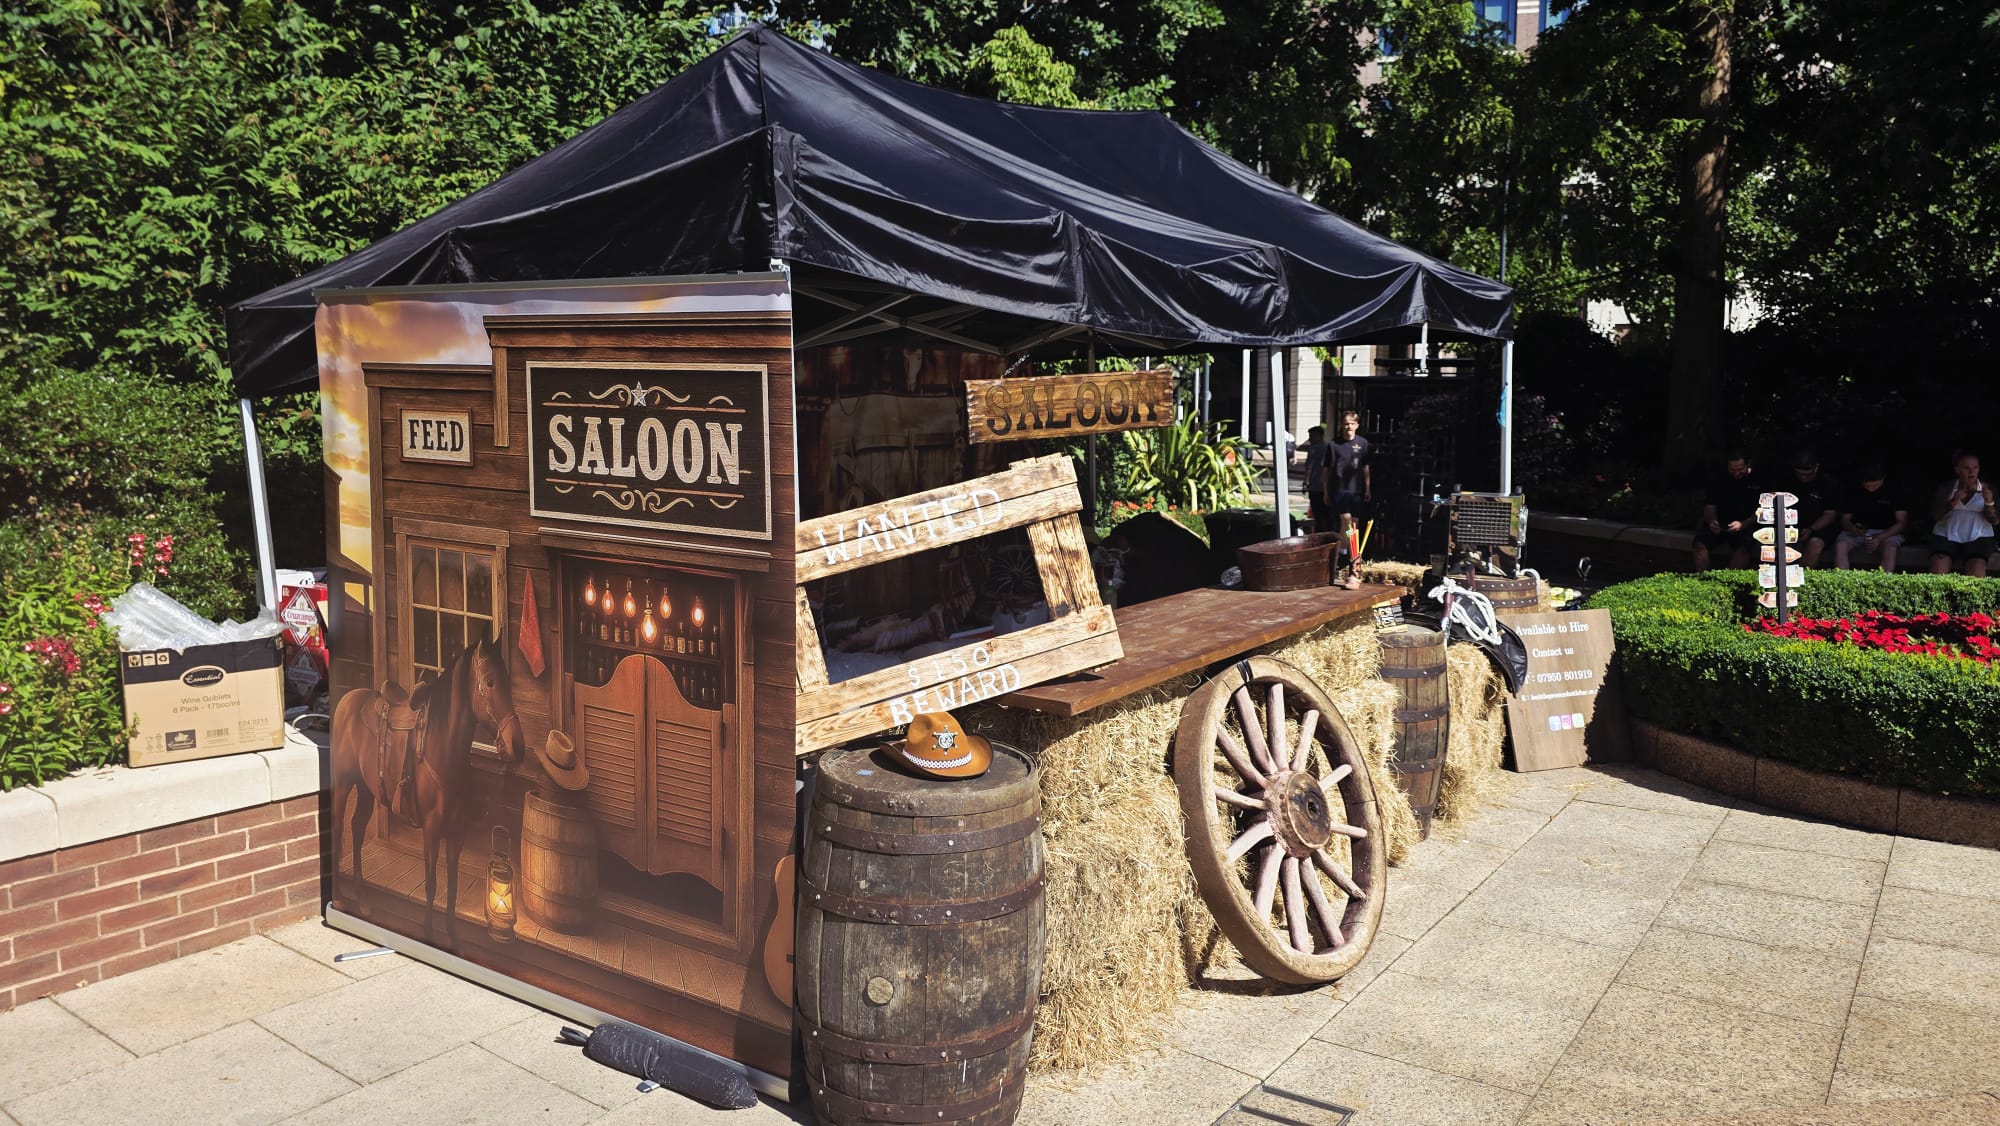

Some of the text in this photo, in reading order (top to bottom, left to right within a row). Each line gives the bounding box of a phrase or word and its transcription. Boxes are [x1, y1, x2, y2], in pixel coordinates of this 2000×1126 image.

[985, 379, 1158, 436] SALOON
[407, 418, 465, 453] FEED
[548, 414, 743, 486] SALOON
[815, 488, 1004, 567] WANTED
[1516, 621, 1590, 636] Available to Hire
[1532, 647, 1574, 658] Contact us
[185, 672, 221, 683] Essential
[907, 646, 991, 689] $150
[1564, 669, 1593, 682] 801919
[181, 693, 232, 705] Wine Goblets
[887, 662, 1022, 728] REWARD
[180, 704, 200, 713] Pack
